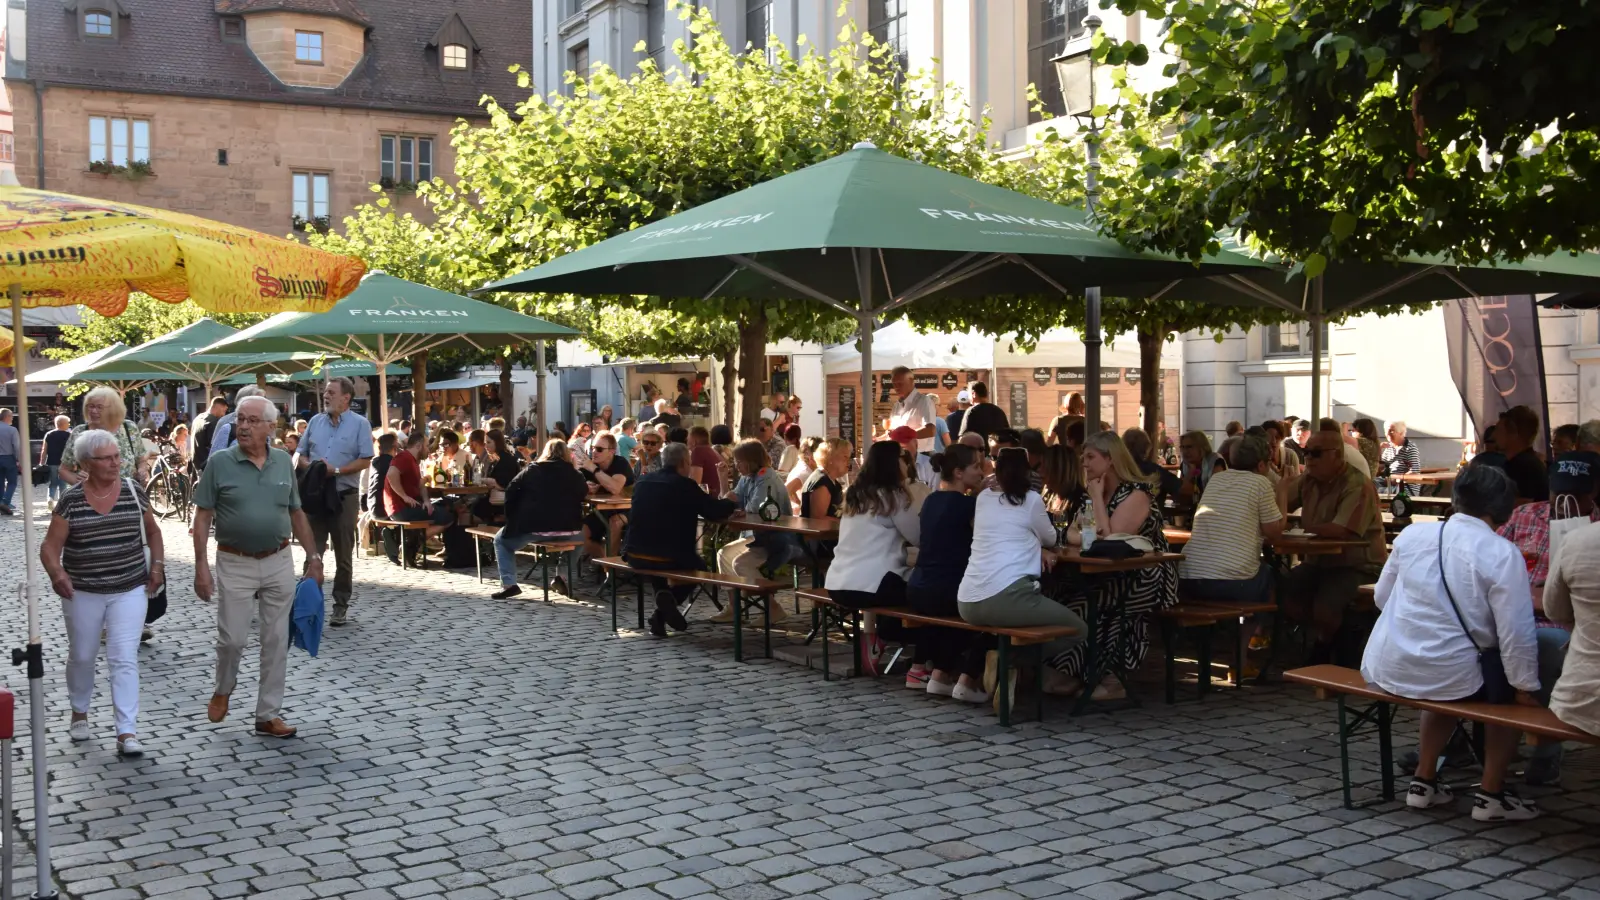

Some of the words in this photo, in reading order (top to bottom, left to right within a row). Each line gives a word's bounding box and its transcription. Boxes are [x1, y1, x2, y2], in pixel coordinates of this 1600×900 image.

[630, 211, 774, 242] FRANKEN
[919, 207, 1095, 232] FRANKEN
[348, 309, 469, 317] FRANKEN
